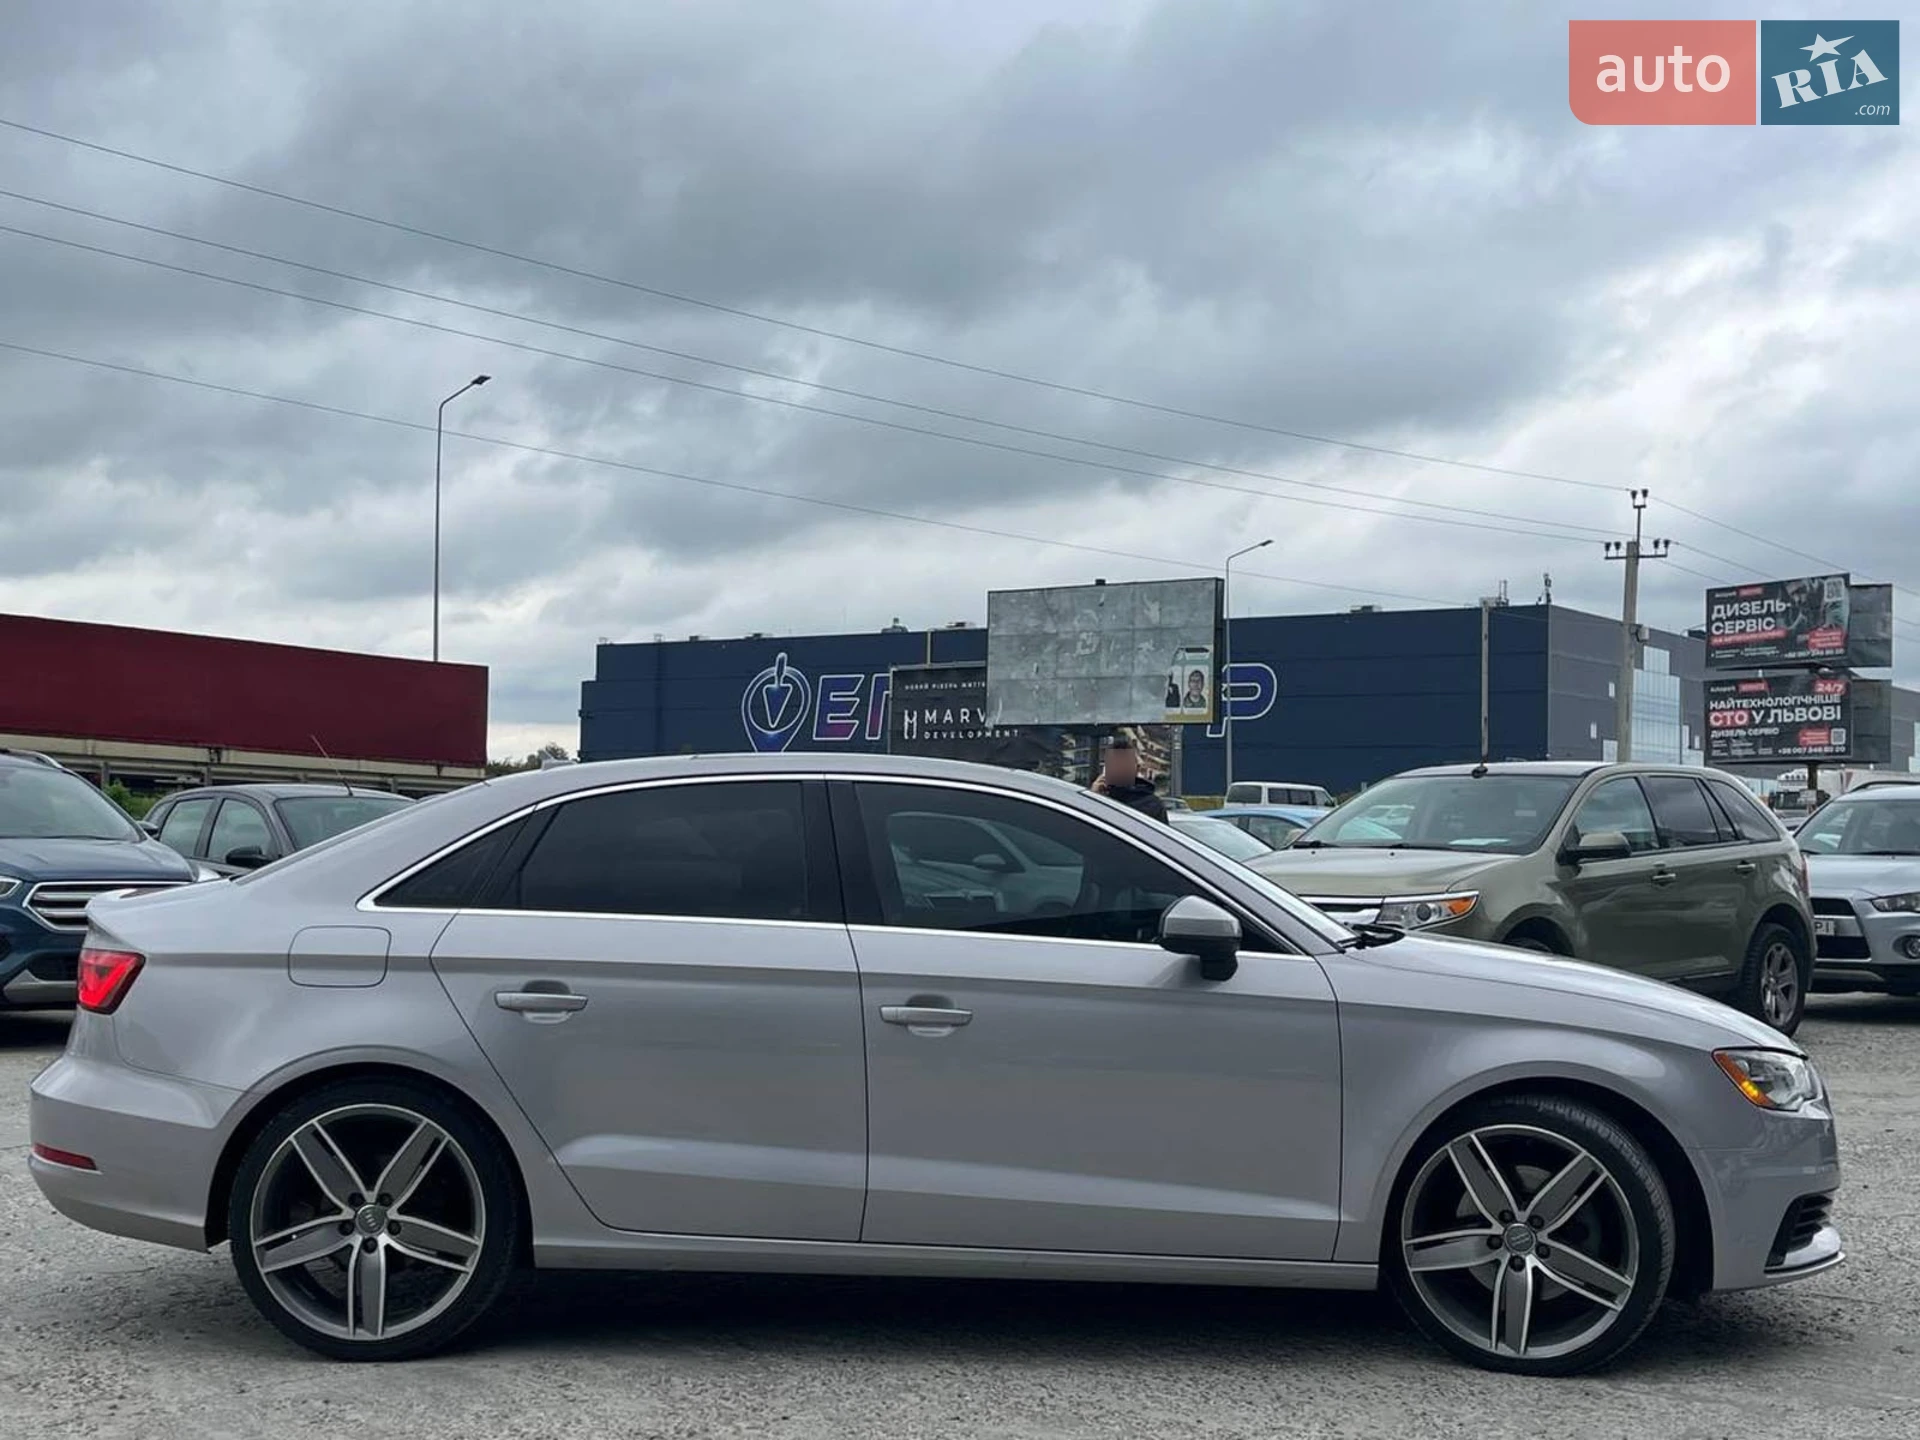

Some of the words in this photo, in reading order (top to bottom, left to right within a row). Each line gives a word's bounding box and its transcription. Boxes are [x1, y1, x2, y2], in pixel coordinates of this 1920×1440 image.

[1711, 617, 1776, 635] СЕРВІС
[1814, 682, 1845, 693] 24/7
[1709, 710, 1748, 727] СТО
[1752, 709, 1765, 724] У
[1767, 705, 1841, 724] ЛЬВОВІ
[924, 729, 1019, 740] DEVELOPMENT
